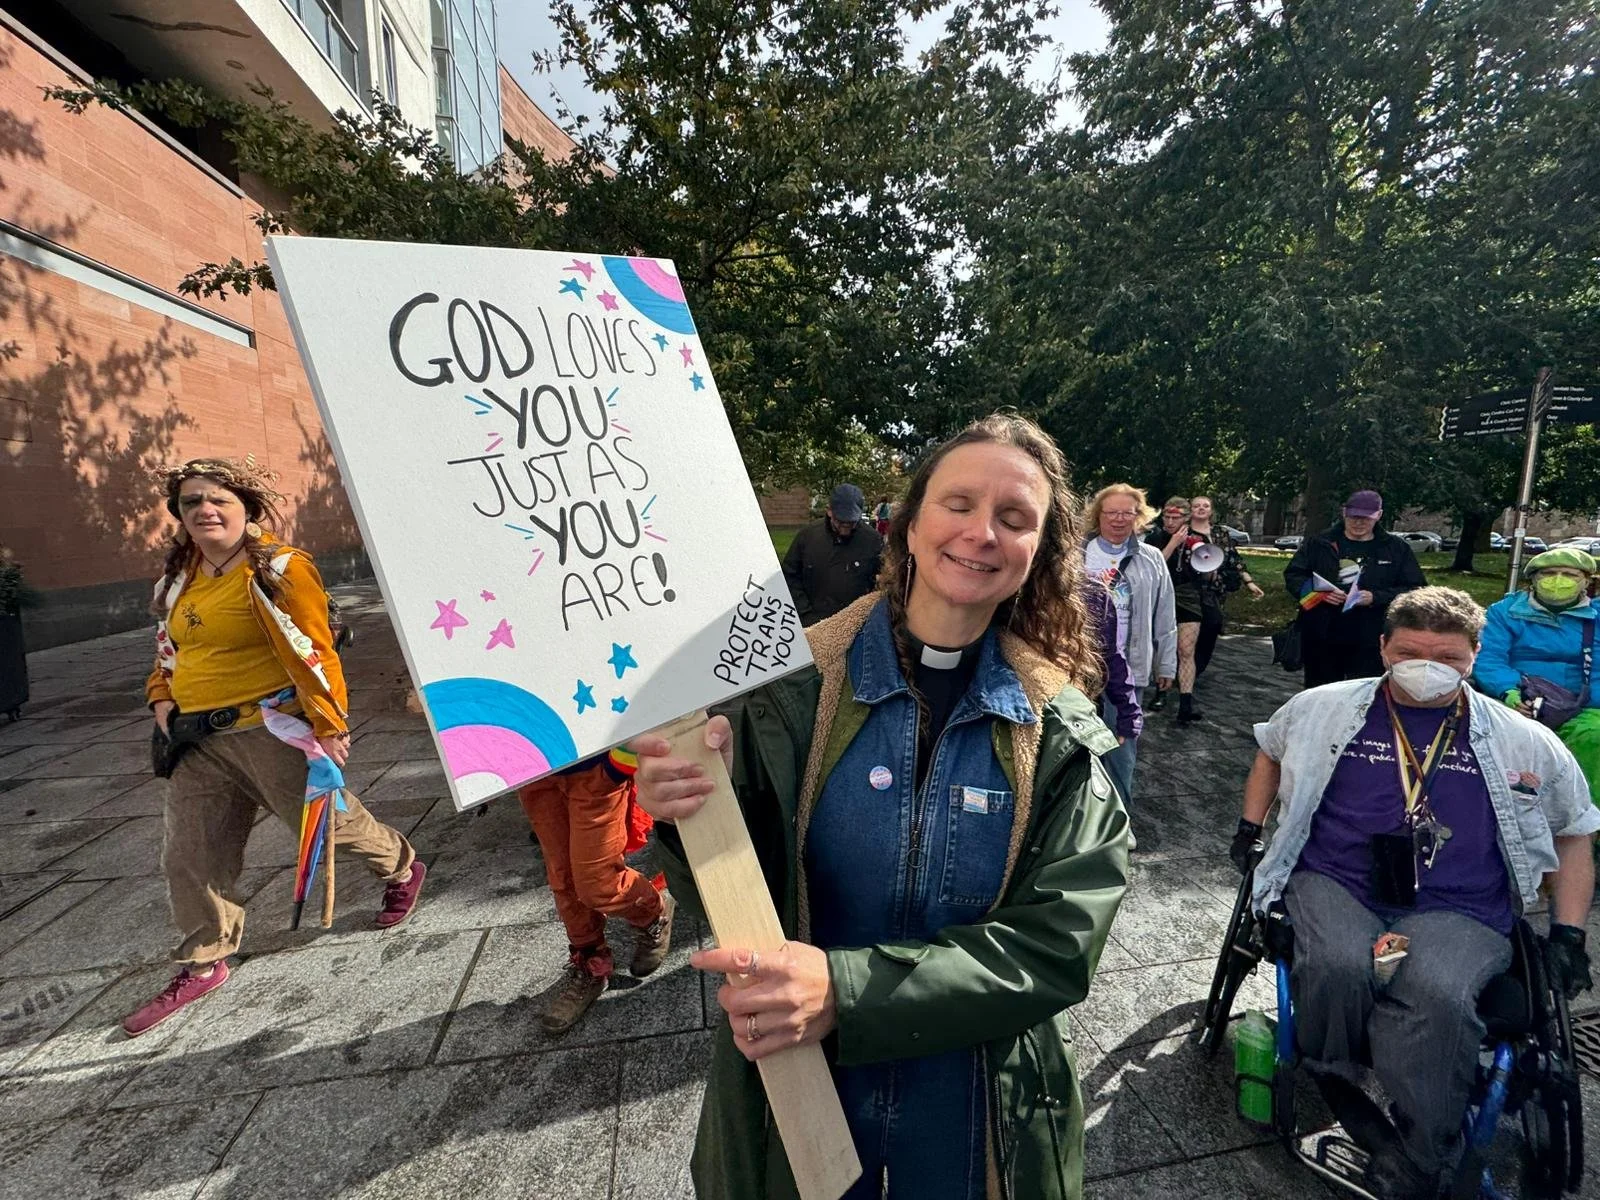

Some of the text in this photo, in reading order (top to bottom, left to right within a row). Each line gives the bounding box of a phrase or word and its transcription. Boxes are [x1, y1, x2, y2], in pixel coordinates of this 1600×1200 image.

[389, 292, 656, 388] GOD LOVES
[482, 384, 608, 450] YOU
[447, 436, 649, 518] JUST AS
[529, 498, 640, 566] YOU
[561, 552, 676, 632] ARE!
[713, 573, 766, 686] PROTECT
[745, 596, 782, 676] TRANS
[771, 603, 796, 667] YOUTH
[1362, 739, 1392, 752] images
